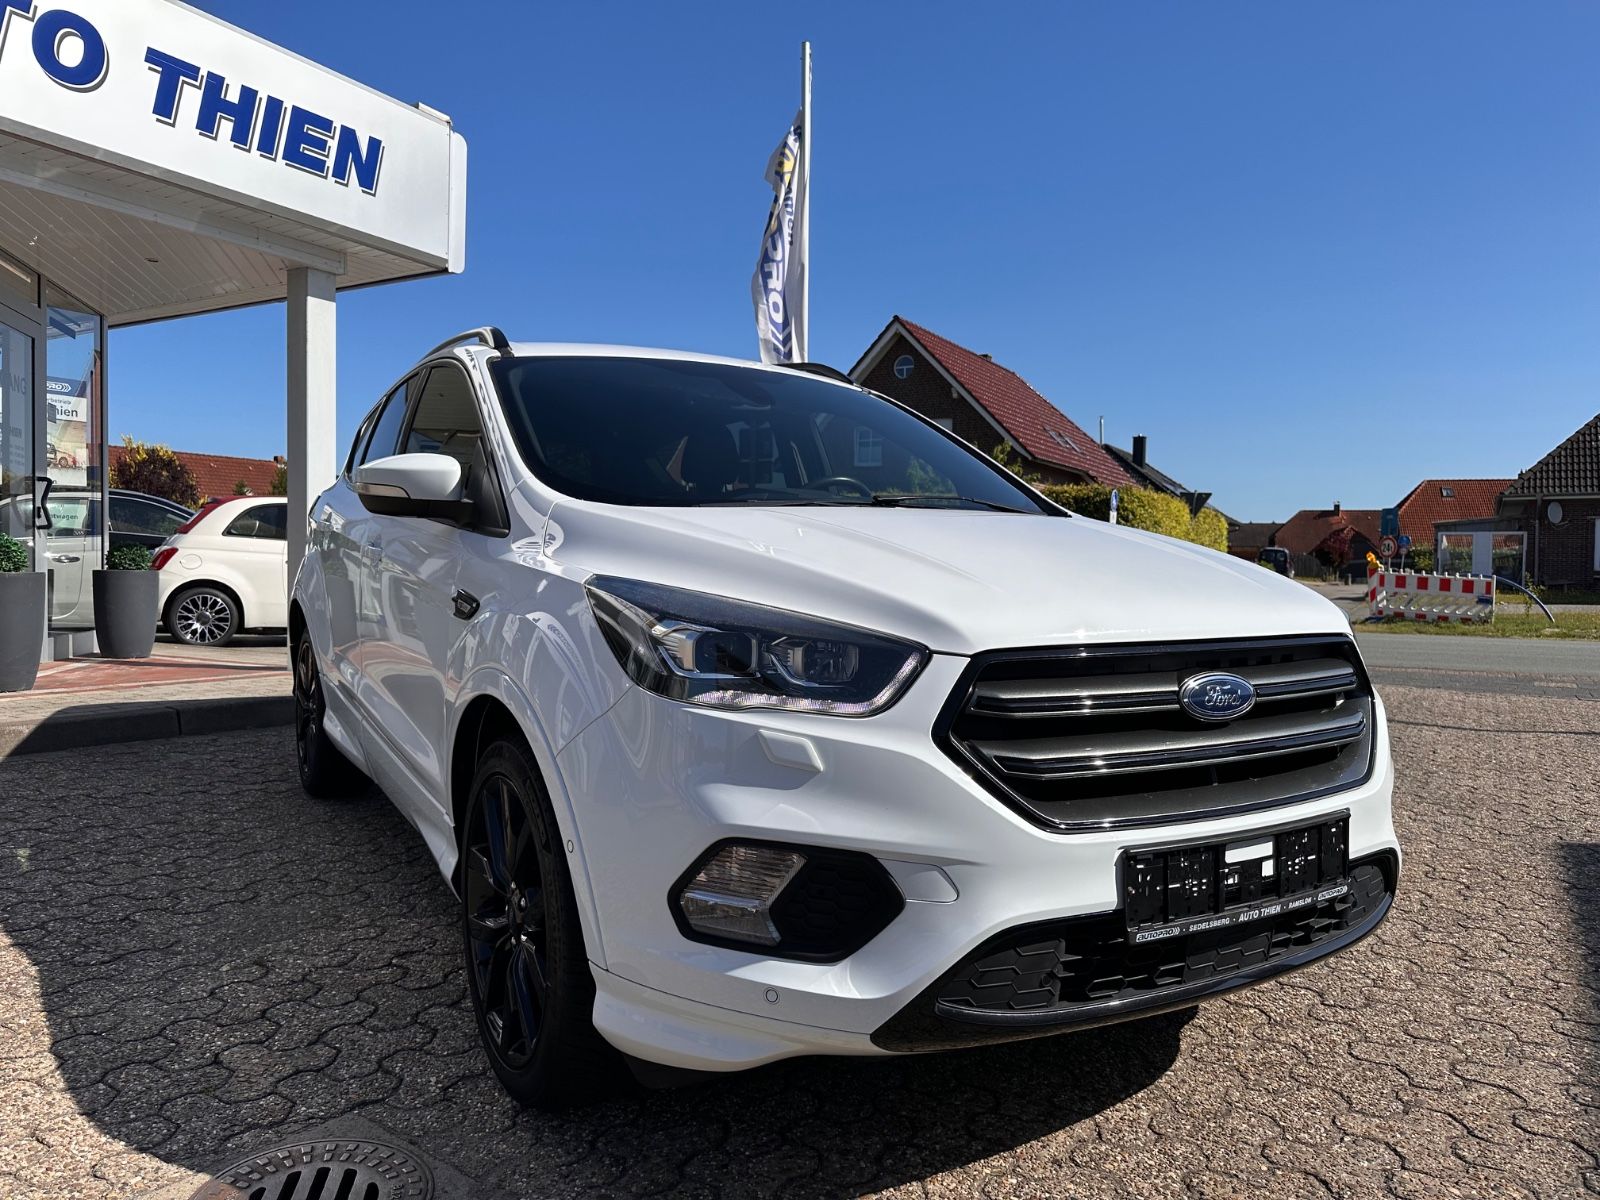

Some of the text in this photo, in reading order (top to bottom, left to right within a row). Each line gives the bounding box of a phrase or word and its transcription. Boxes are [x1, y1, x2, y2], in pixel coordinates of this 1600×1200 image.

[145, 47, 385, 197] THIEN
[1205, 684, 1241, 706] Ford
[1189, 917, 1230, 932] SEDELSBERG
[1238, 909, 1259, 922] AUTO
[1260, 903, 1281, 917] THIEN
